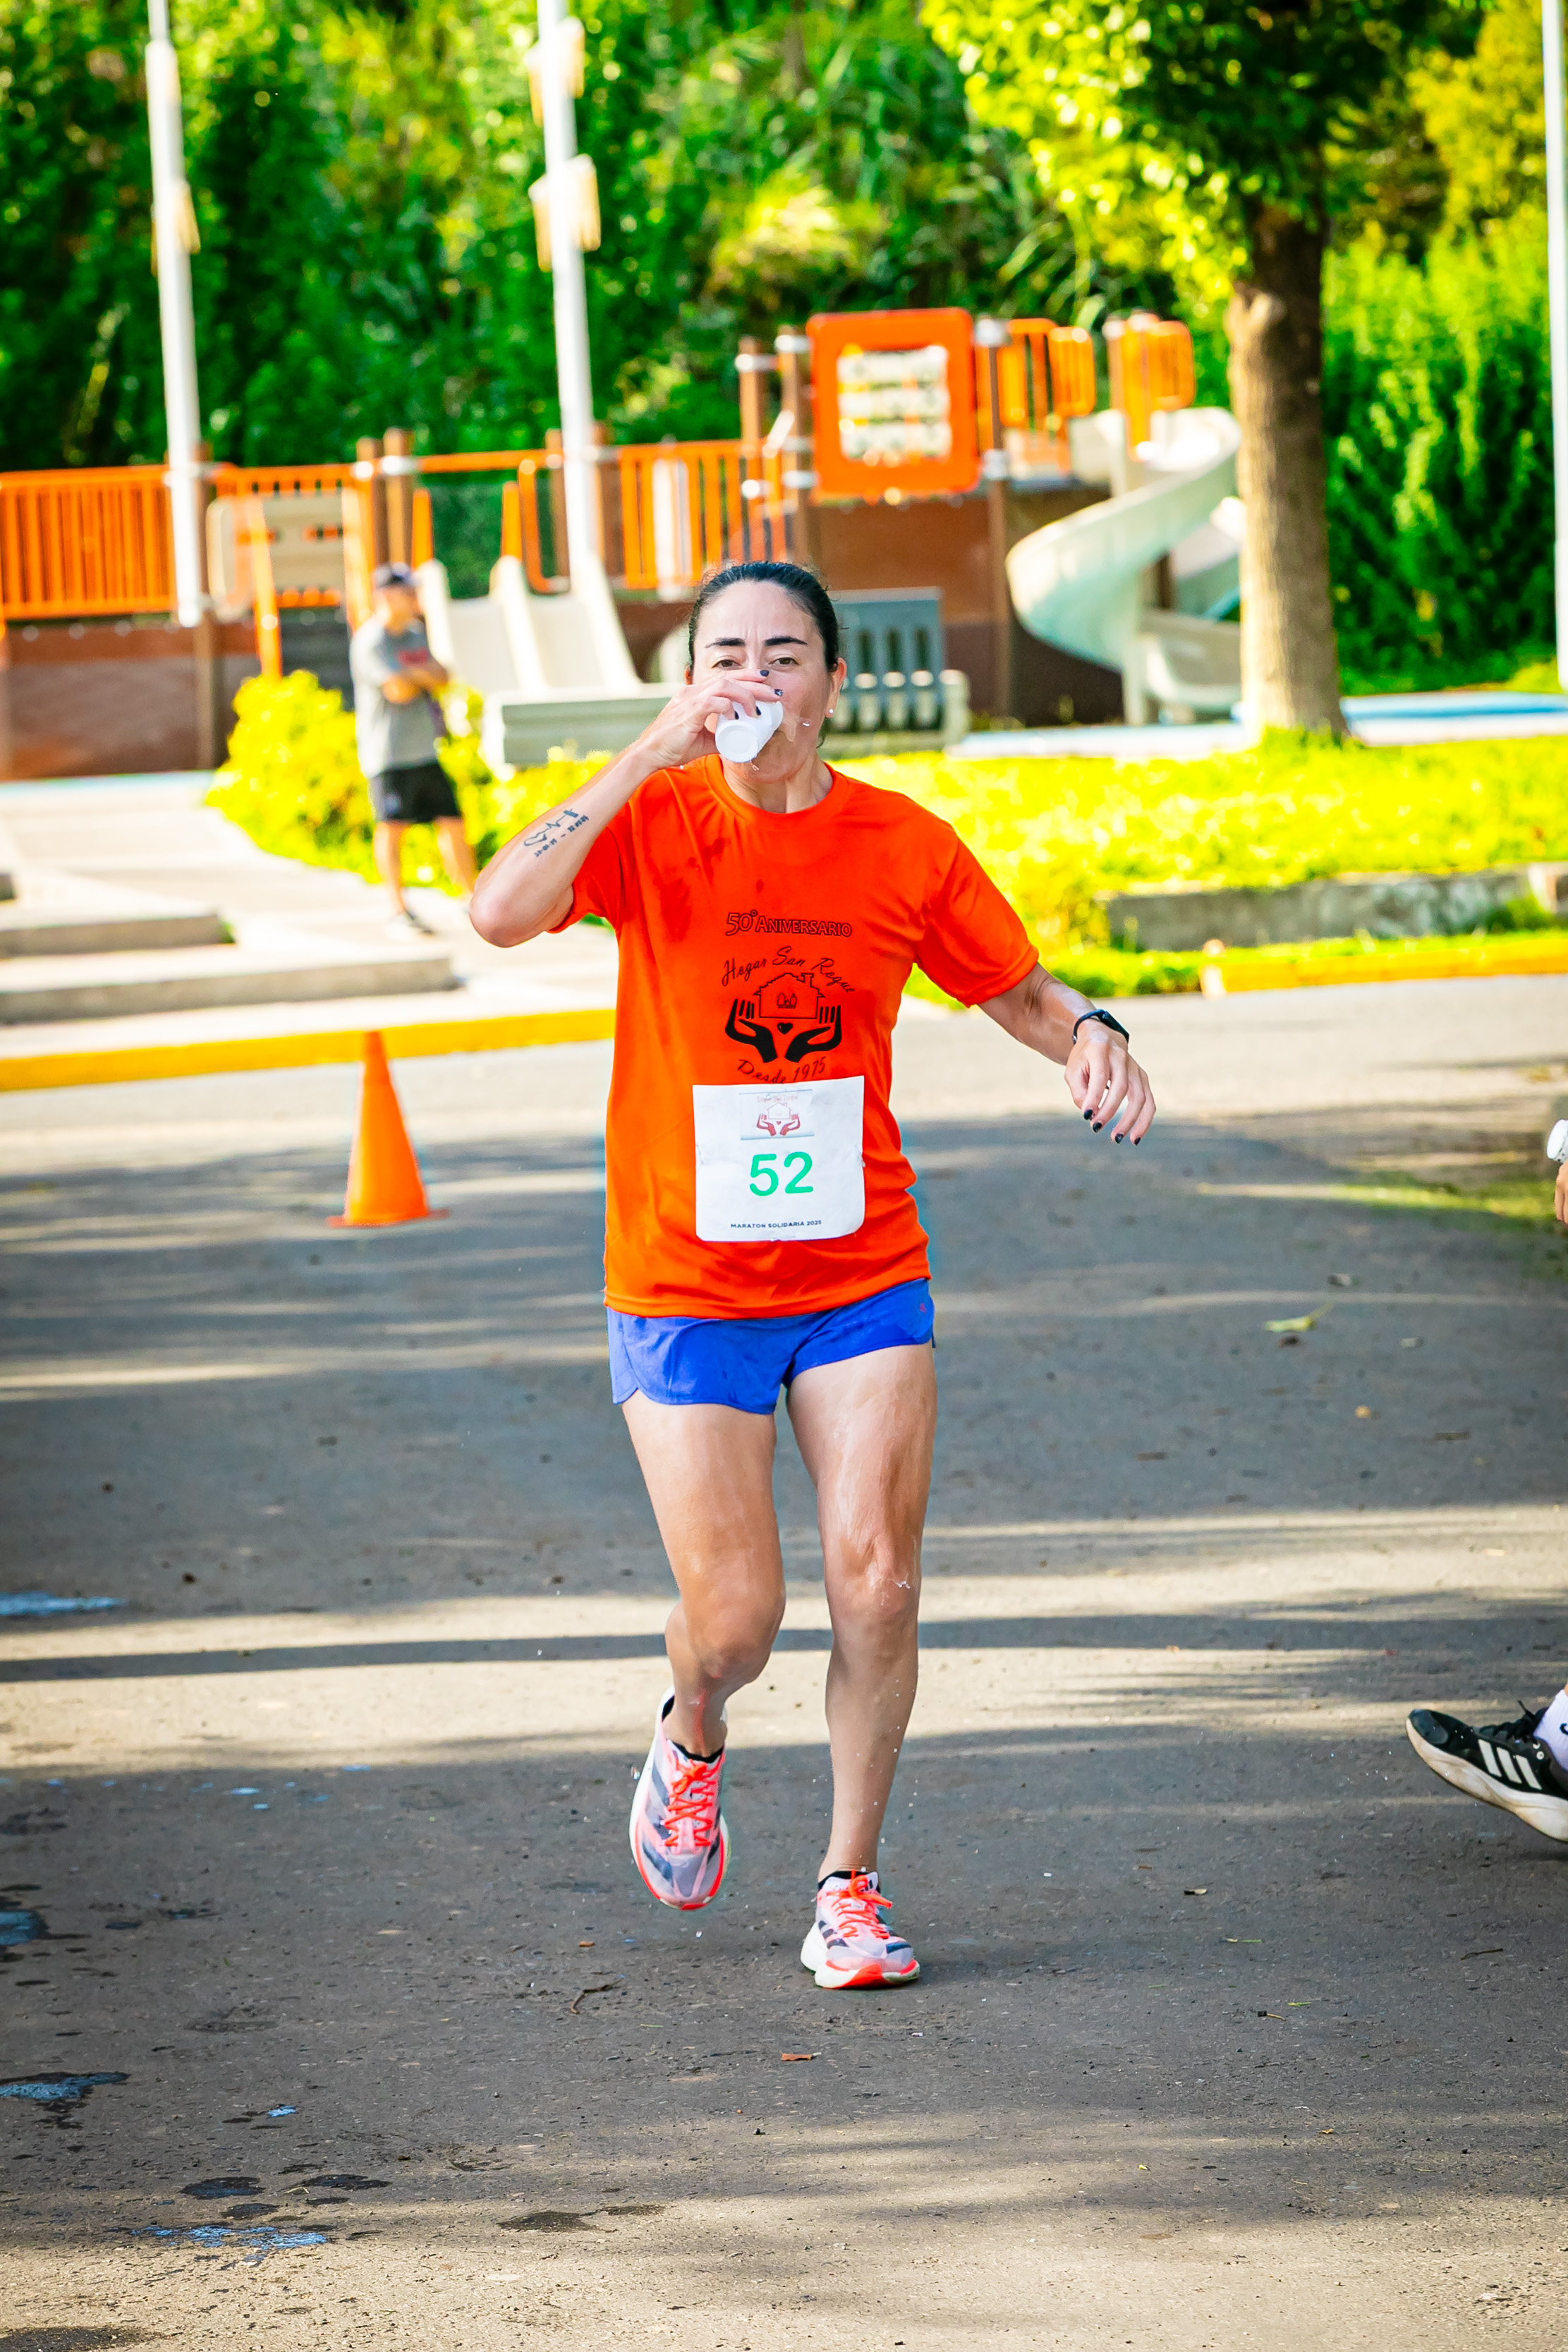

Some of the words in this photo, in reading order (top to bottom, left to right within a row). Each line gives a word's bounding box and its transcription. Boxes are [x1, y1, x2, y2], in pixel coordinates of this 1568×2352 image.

[722, 957, 767, 986] Hogar
[772, 946, 806, 967] San
[812, 957, 856, 993] Roque
[737, 1059, 786, 1084] Desde
[794, 1056, 826, 1082] 1975
[749, 1151, 814, 1196] 52
